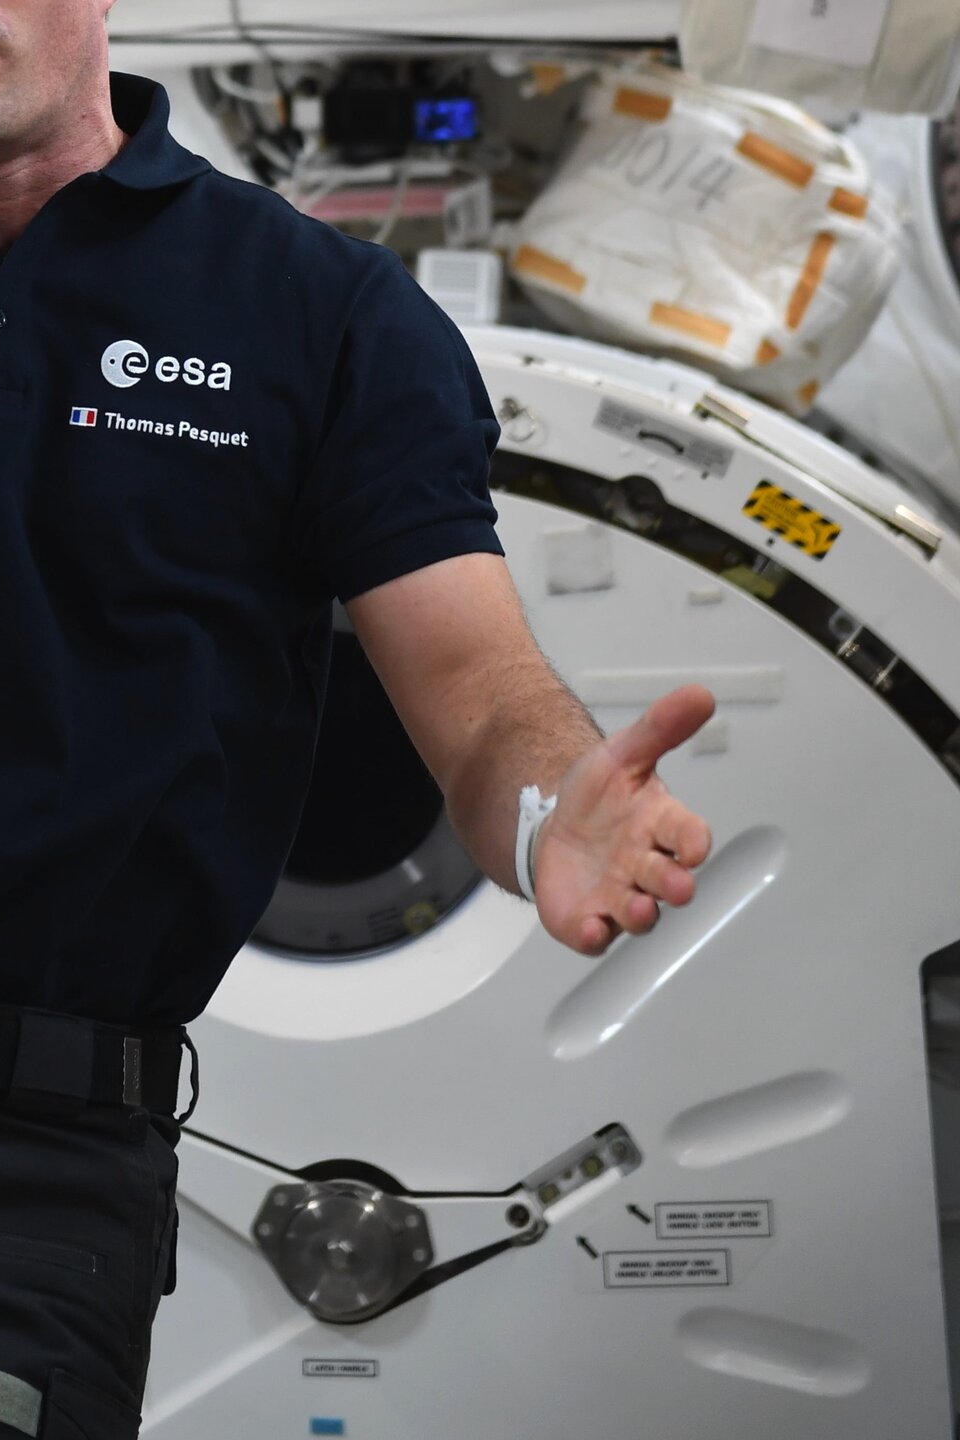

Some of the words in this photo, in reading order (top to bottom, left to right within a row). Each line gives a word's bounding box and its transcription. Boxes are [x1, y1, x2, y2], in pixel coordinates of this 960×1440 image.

[155, 356, 232, 391] esa
[105, 412, 175, 436] Thomas
[178, 420, 249, 448] Pesquet
